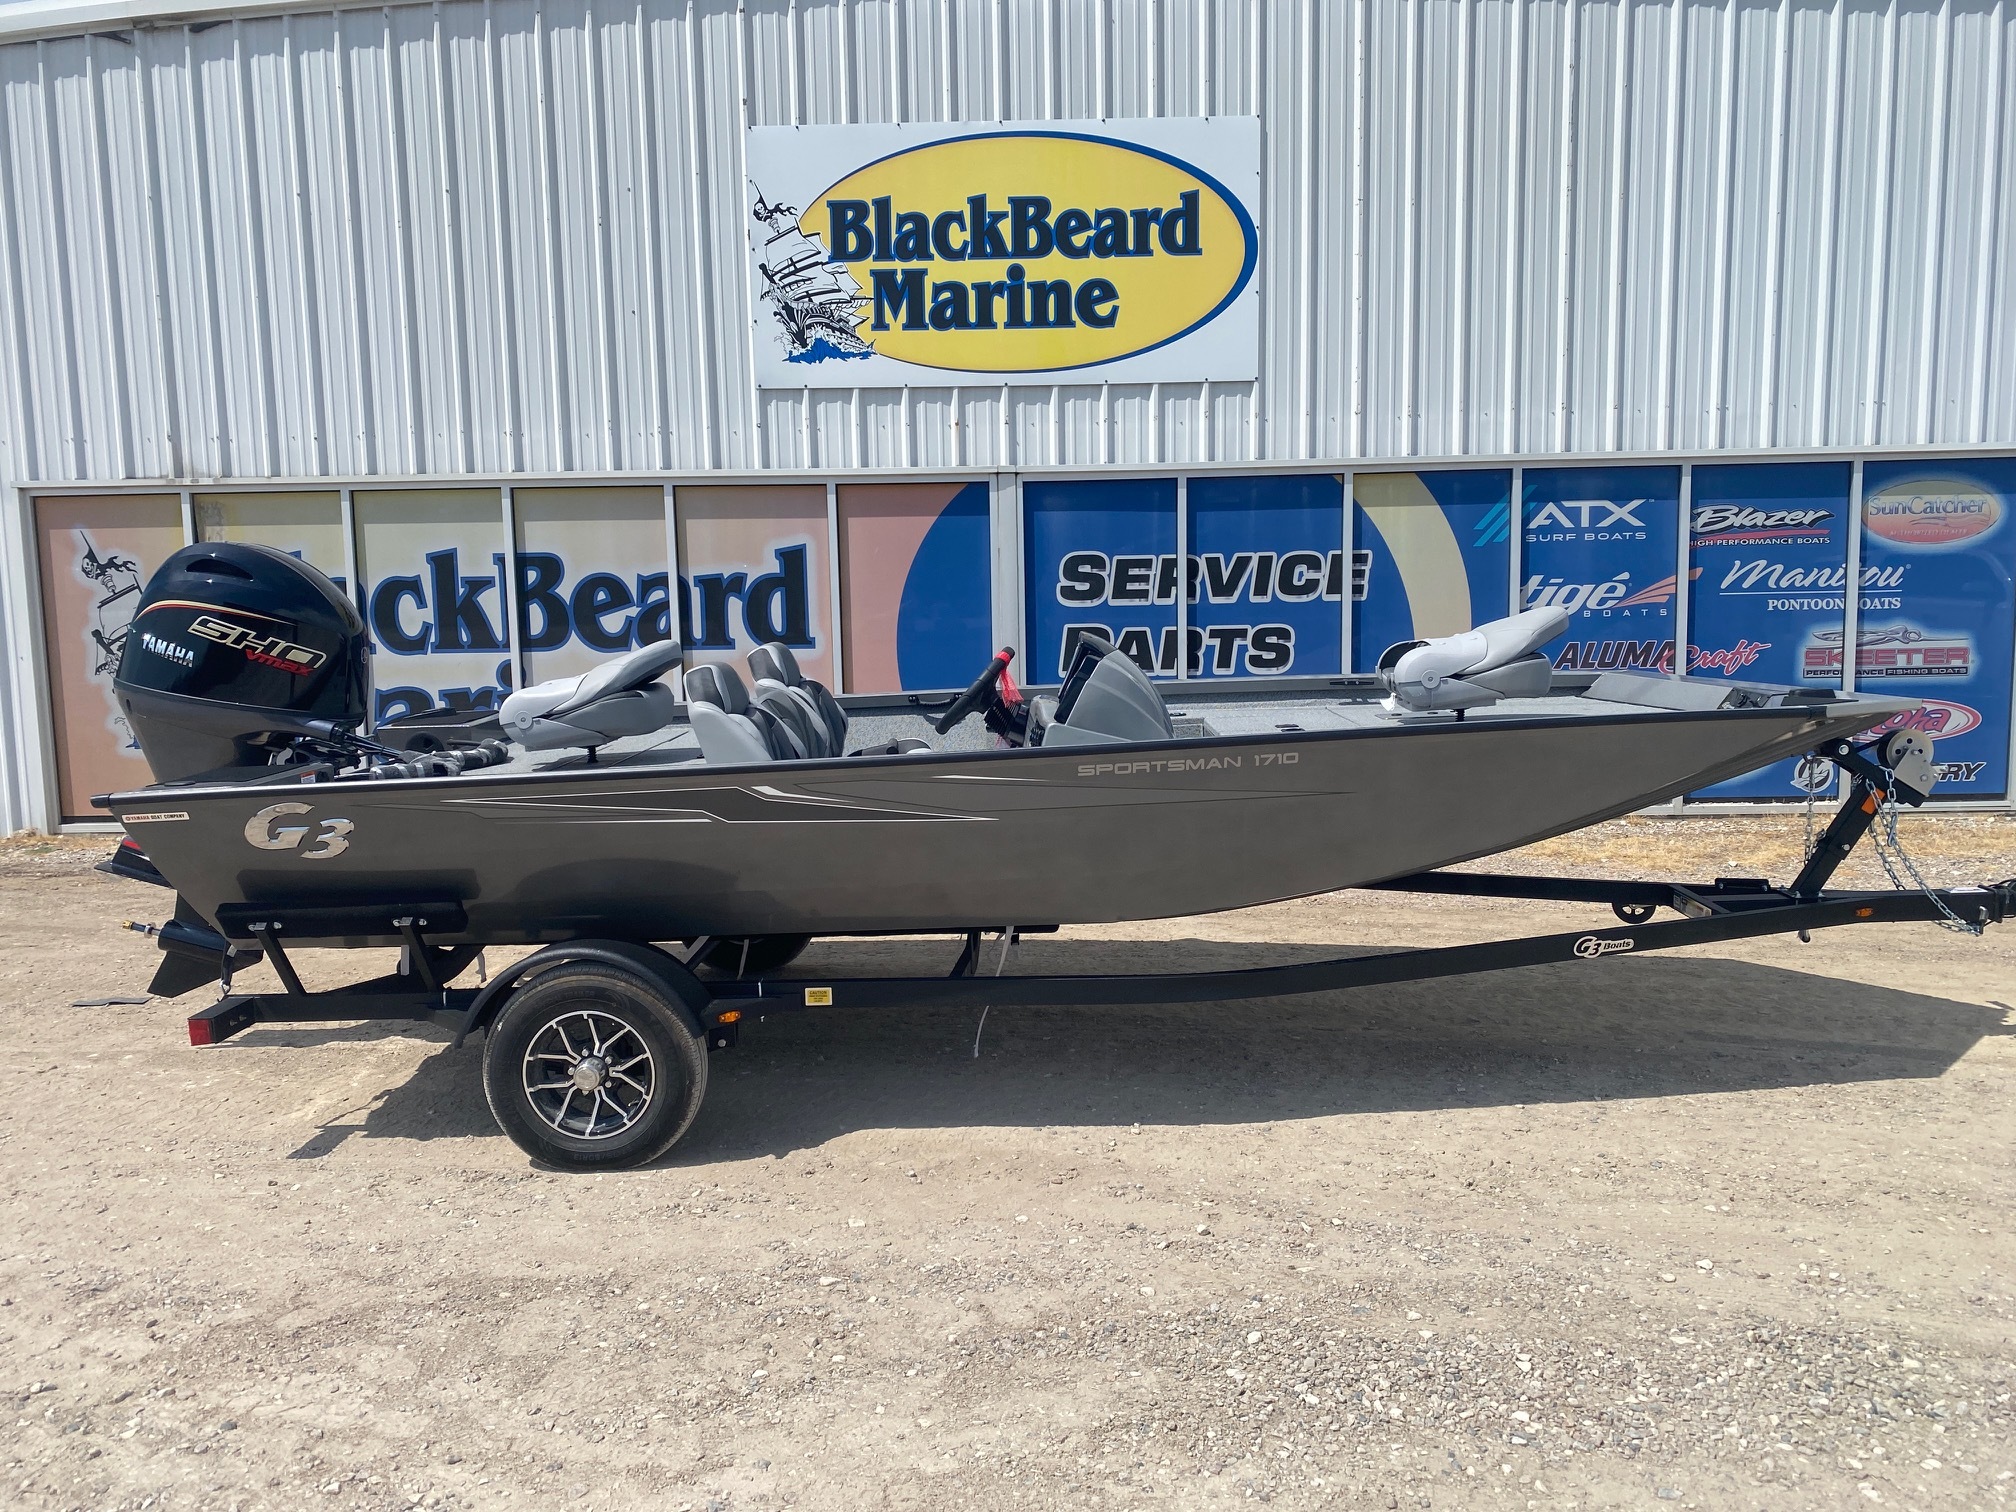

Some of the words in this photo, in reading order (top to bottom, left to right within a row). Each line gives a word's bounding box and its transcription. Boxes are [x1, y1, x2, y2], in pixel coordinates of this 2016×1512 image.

[826, 189, 1203, 263] BlackBeard
[870, 262, 1120, 331] Marine
[1526, 499, 1648, 529] ATX
[1690, 503, 1835, 534] Blazer
[1868, 494, 1987, 516] SunCatcher
[1525, 533, 1577, 542] SURF
[1584, 532, 1647, 541] BOATS
[1716, 538, 1794, 546] PERFORMANCE
[1057, 550, 1372, 607] SERVICE
[1720, 559, 1905, 589] Maniou
[288, 543, 816, 655] ckBeard
[1583, 608, 1668, 618] BOATS
[1767, 597, 1846, 611] PONTOON
[1852, 597, 1902, 610] OATS
[141, 632, 195, 668] YAMAHA
[187, 615, 327, 669] SHO
[1805, 669, 1884, 677] PERFOANCE
[1931, 667, 1967, 675] BOATS
[1077, 756, 1242, 777] SPORTSMAN
[1254, 752, 1299, 767] 1710
[243, 802, 355, 860] G3
[1574, 936, 1602, 958] G3
[1603, 940, 1631, 950] Boats
